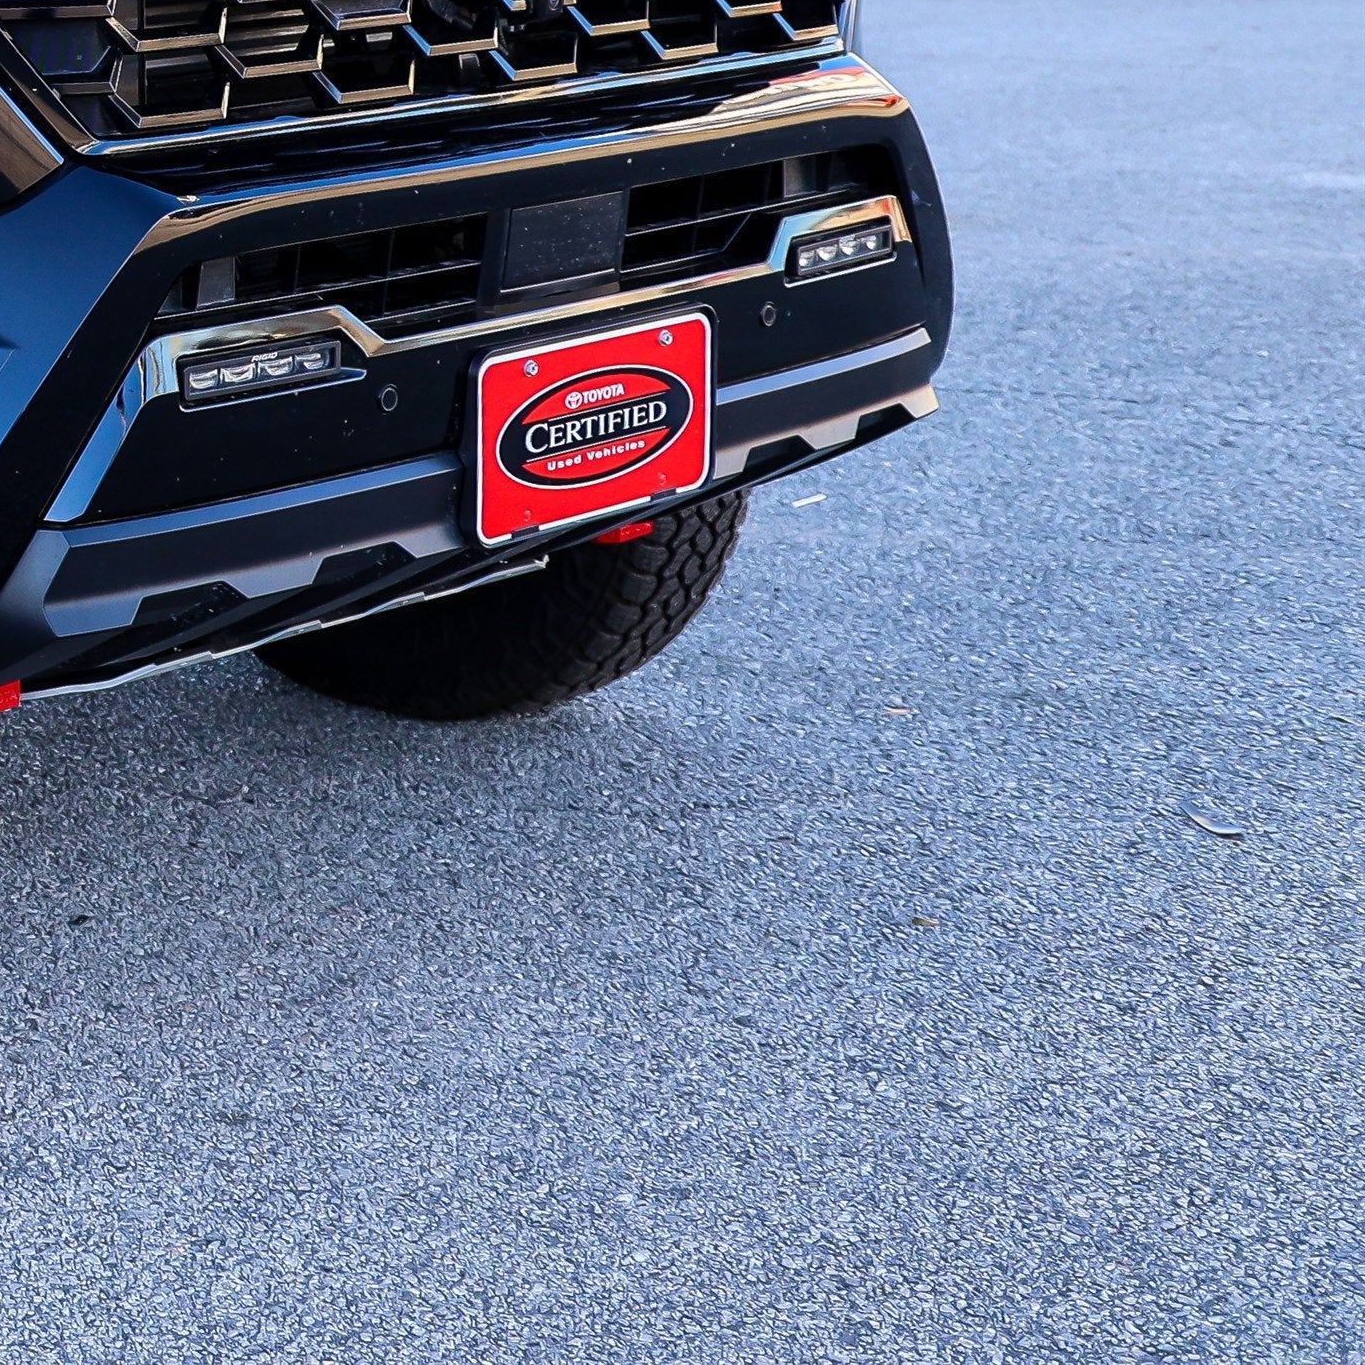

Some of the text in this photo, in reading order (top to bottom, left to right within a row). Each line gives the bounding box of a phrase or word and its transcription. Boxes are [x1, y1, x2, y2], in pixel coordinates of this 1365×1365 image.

[251, 351, 278, 362] RIGID
[583, 383, 625, 405] TOYOTA
[525, 401, 666, 453] CERTIFIED
[547, 440, 645, 471] Used Vehicles
